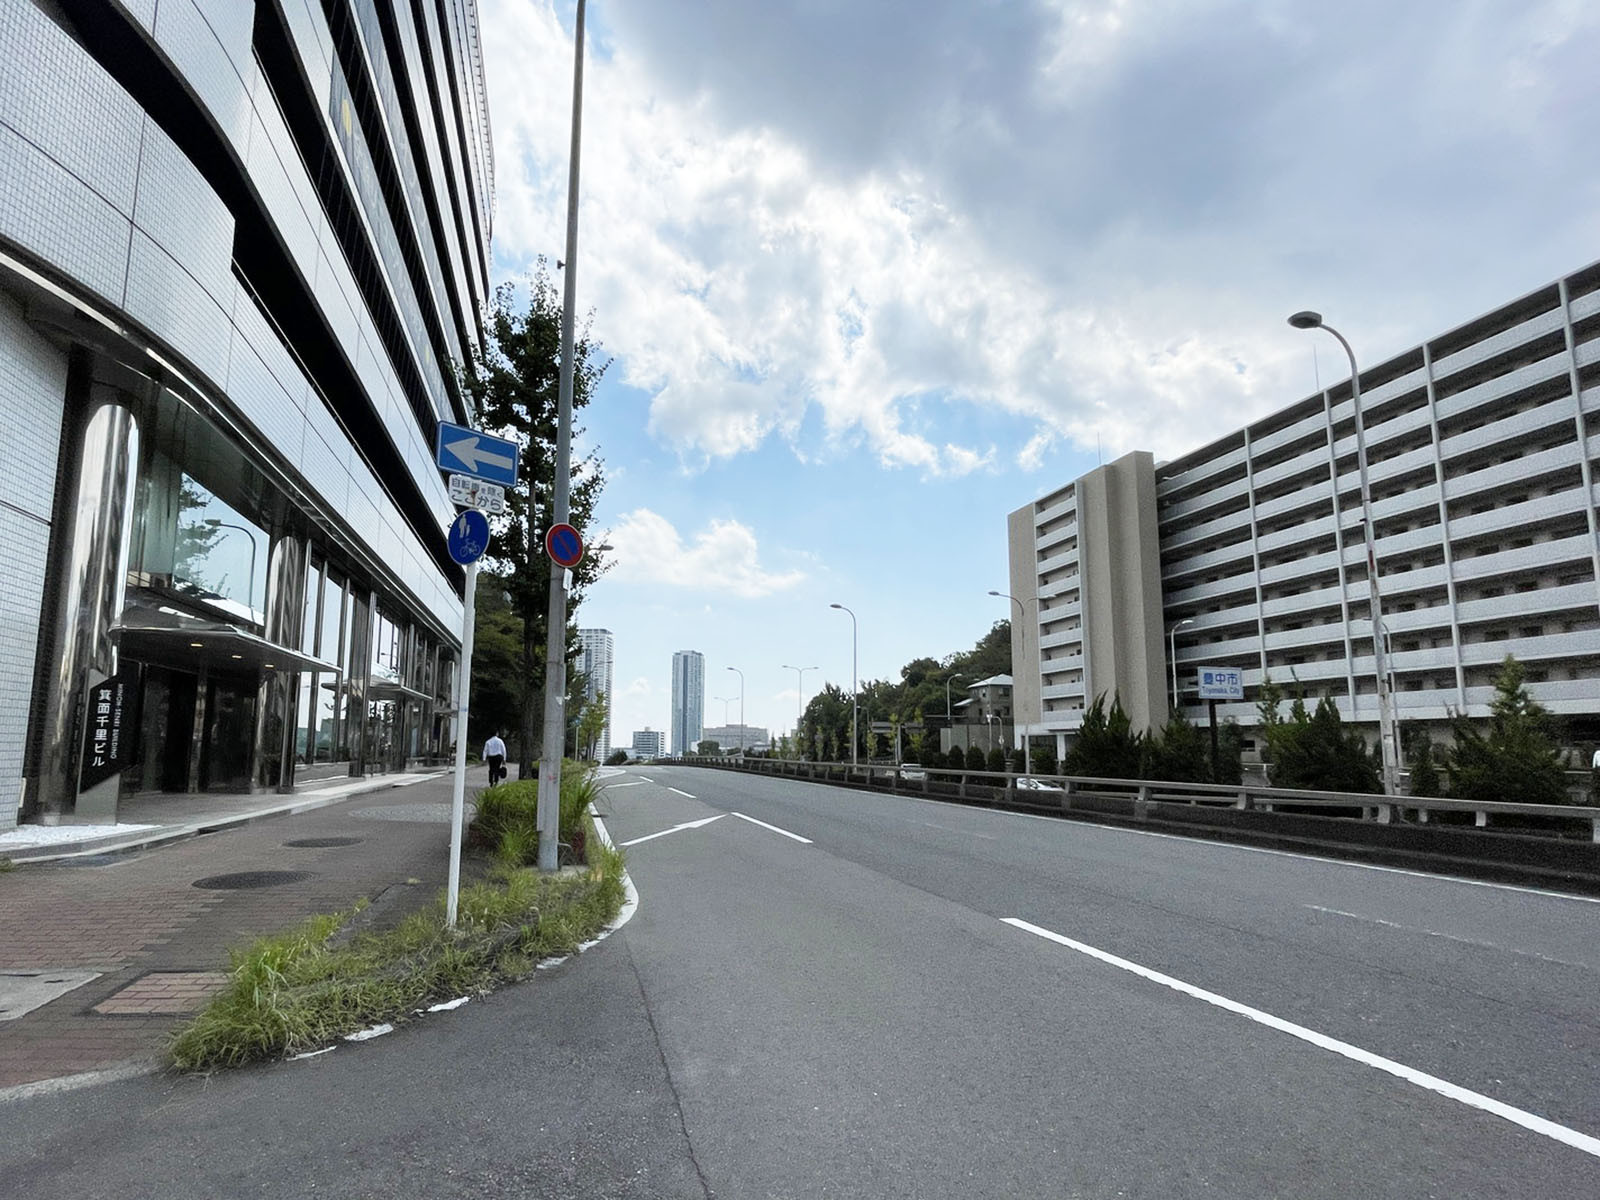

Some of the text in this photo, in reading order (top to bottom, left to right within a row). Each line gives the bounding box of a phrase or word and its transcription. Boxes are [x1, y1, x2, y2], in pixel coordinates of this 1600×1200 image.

[451, 489, 501, 511] ここから
[1203, 672, 1238, 685] 豊中市
[92, 689, 112, 767] 箕面千里ビル
